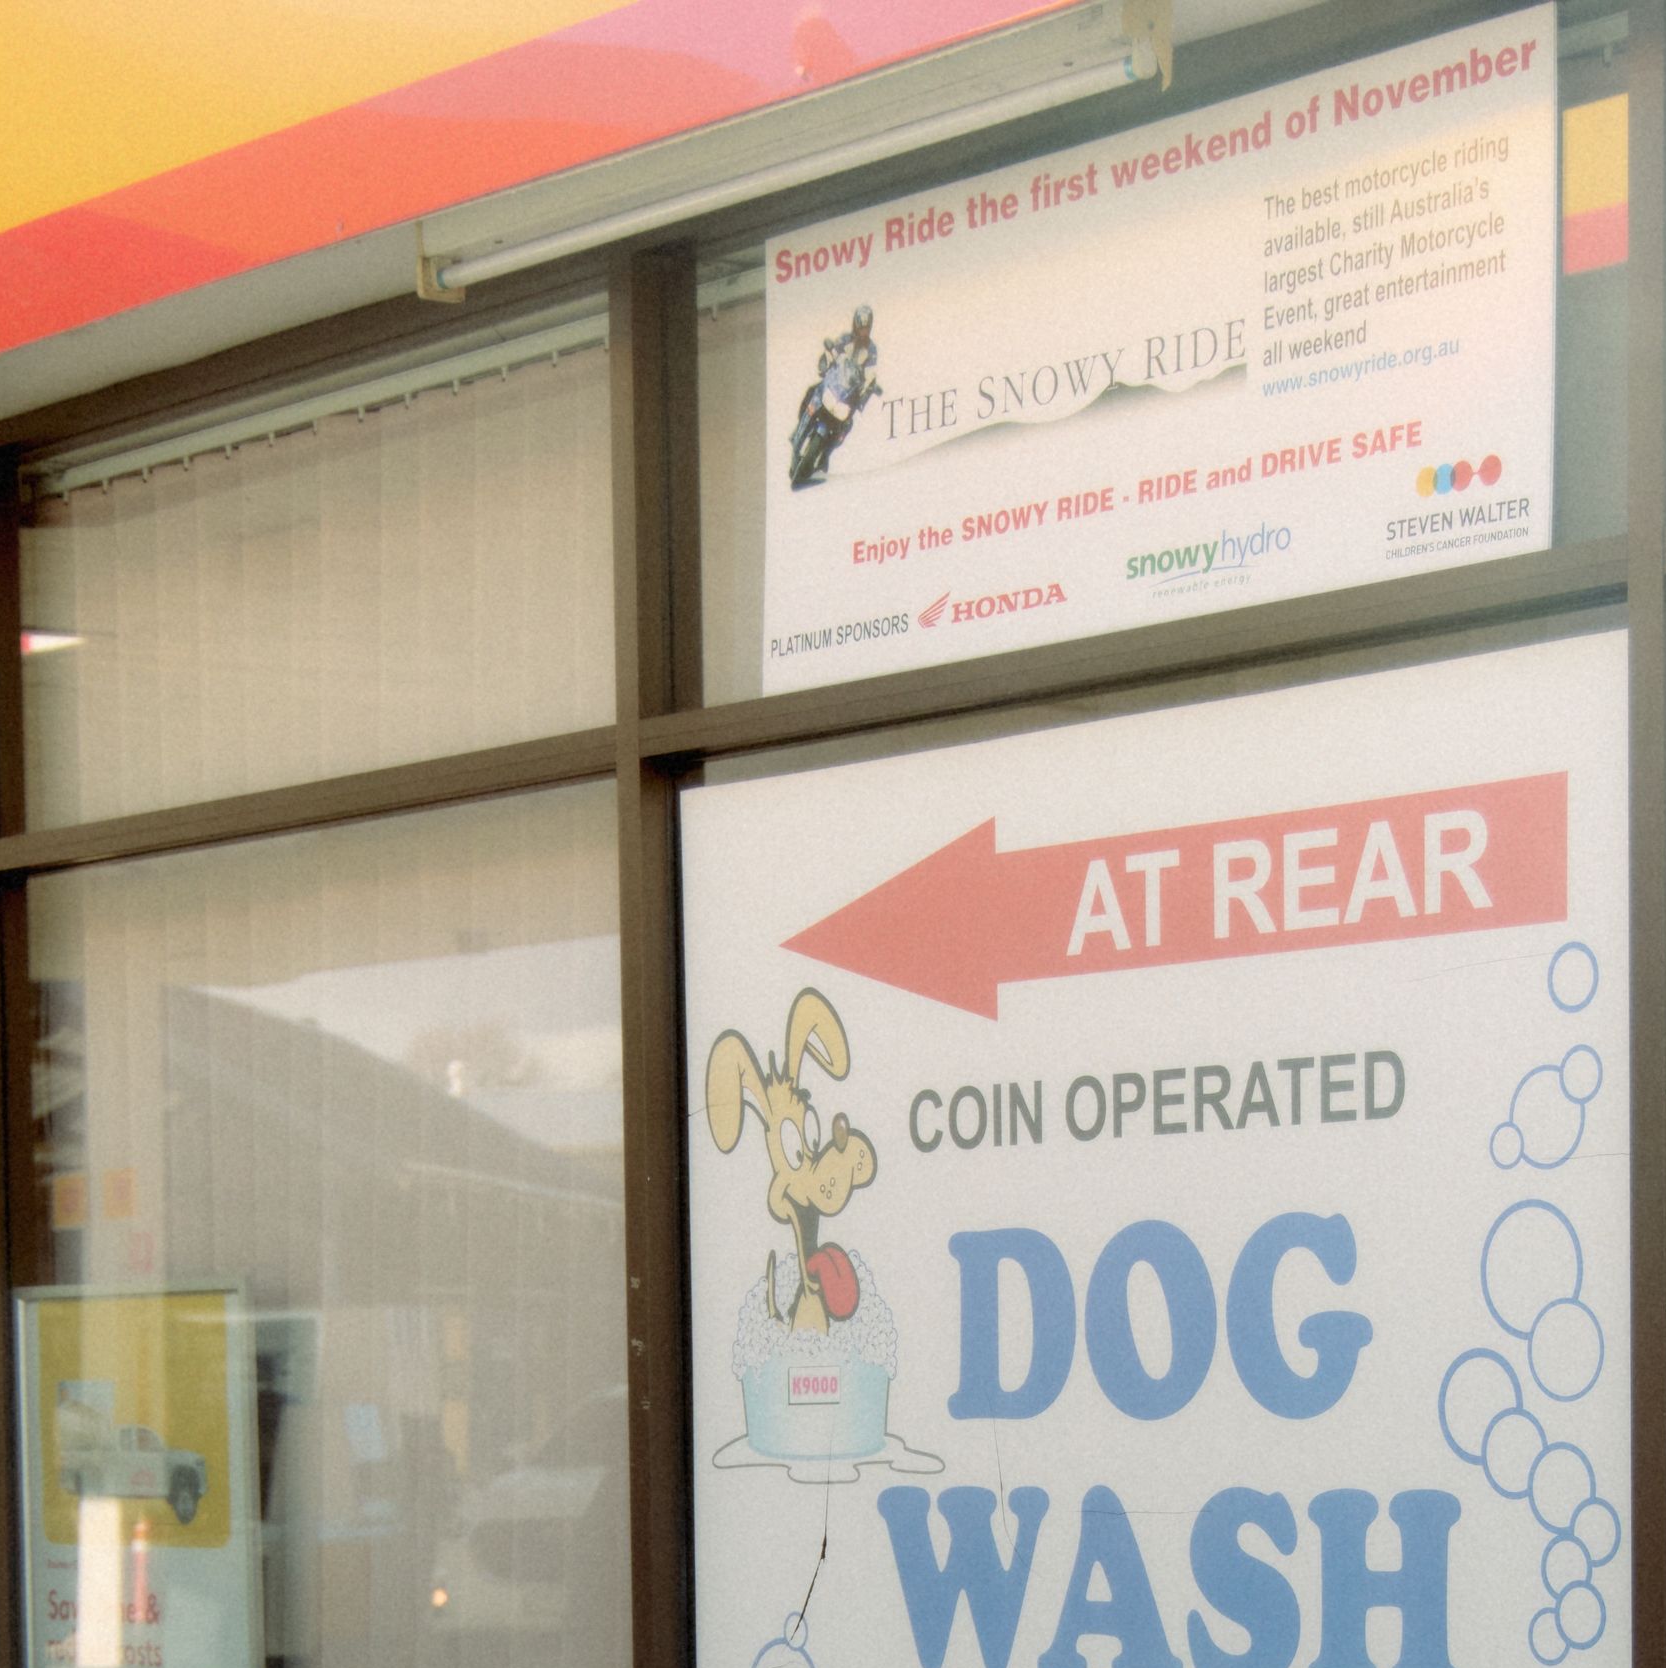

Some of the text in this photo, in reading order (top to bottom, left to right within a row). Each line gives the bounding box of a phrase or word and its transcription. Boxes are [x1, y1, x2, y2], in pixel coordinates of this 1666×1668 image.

[775, 38, 1537, 285] Snowy Ride the first weekend of November
[1263, 134, 1511, 221] The best motorcycle riding
[1263, 177, 1491, 258] available, still Australia's
[1263, 211, 1506, 295] largest Charity Motorcycle
[1263, 250, 1507, 331] Event, great entertainment
[882, 318, 1247, 441] THE SNOWY RIDE
[1262, 320, 1368, 368] all weekend
[1262, 337, 1461, 399] www.snowyride.org.au
[852, 535, 911, 565] Enjoy
[918, 526, 954, 551] the
[961, 501, 1050, 543] SNOWY
[1056, 487, 1116, 523] RIDE
[1138, 469, 1199, 505] RIDE
[1205, 457, 1253, 492] and
[1260, 438, 1343, 479] DRIVE
[1351, 421, 1424, 461] SAFE
[1386, 497, 1532, 543] STEVEN WALTER
[1385, 526, 1531, 562] CHILDREN'S CANCER FOUNDATION
[951, 582, 1069, 625] HONDA
[1151, 572, 1253, 601] renewable energy
[770, 612, 911, 660] PLATINUM SPONSORS
[1065, 808, 1494, 957] AT REAR
[908, 1049, 1407, 1153] COIN OPERATED
[948, 1212, 1374, 1421] DOG
[792, 1376, 838, 1395] K9000
